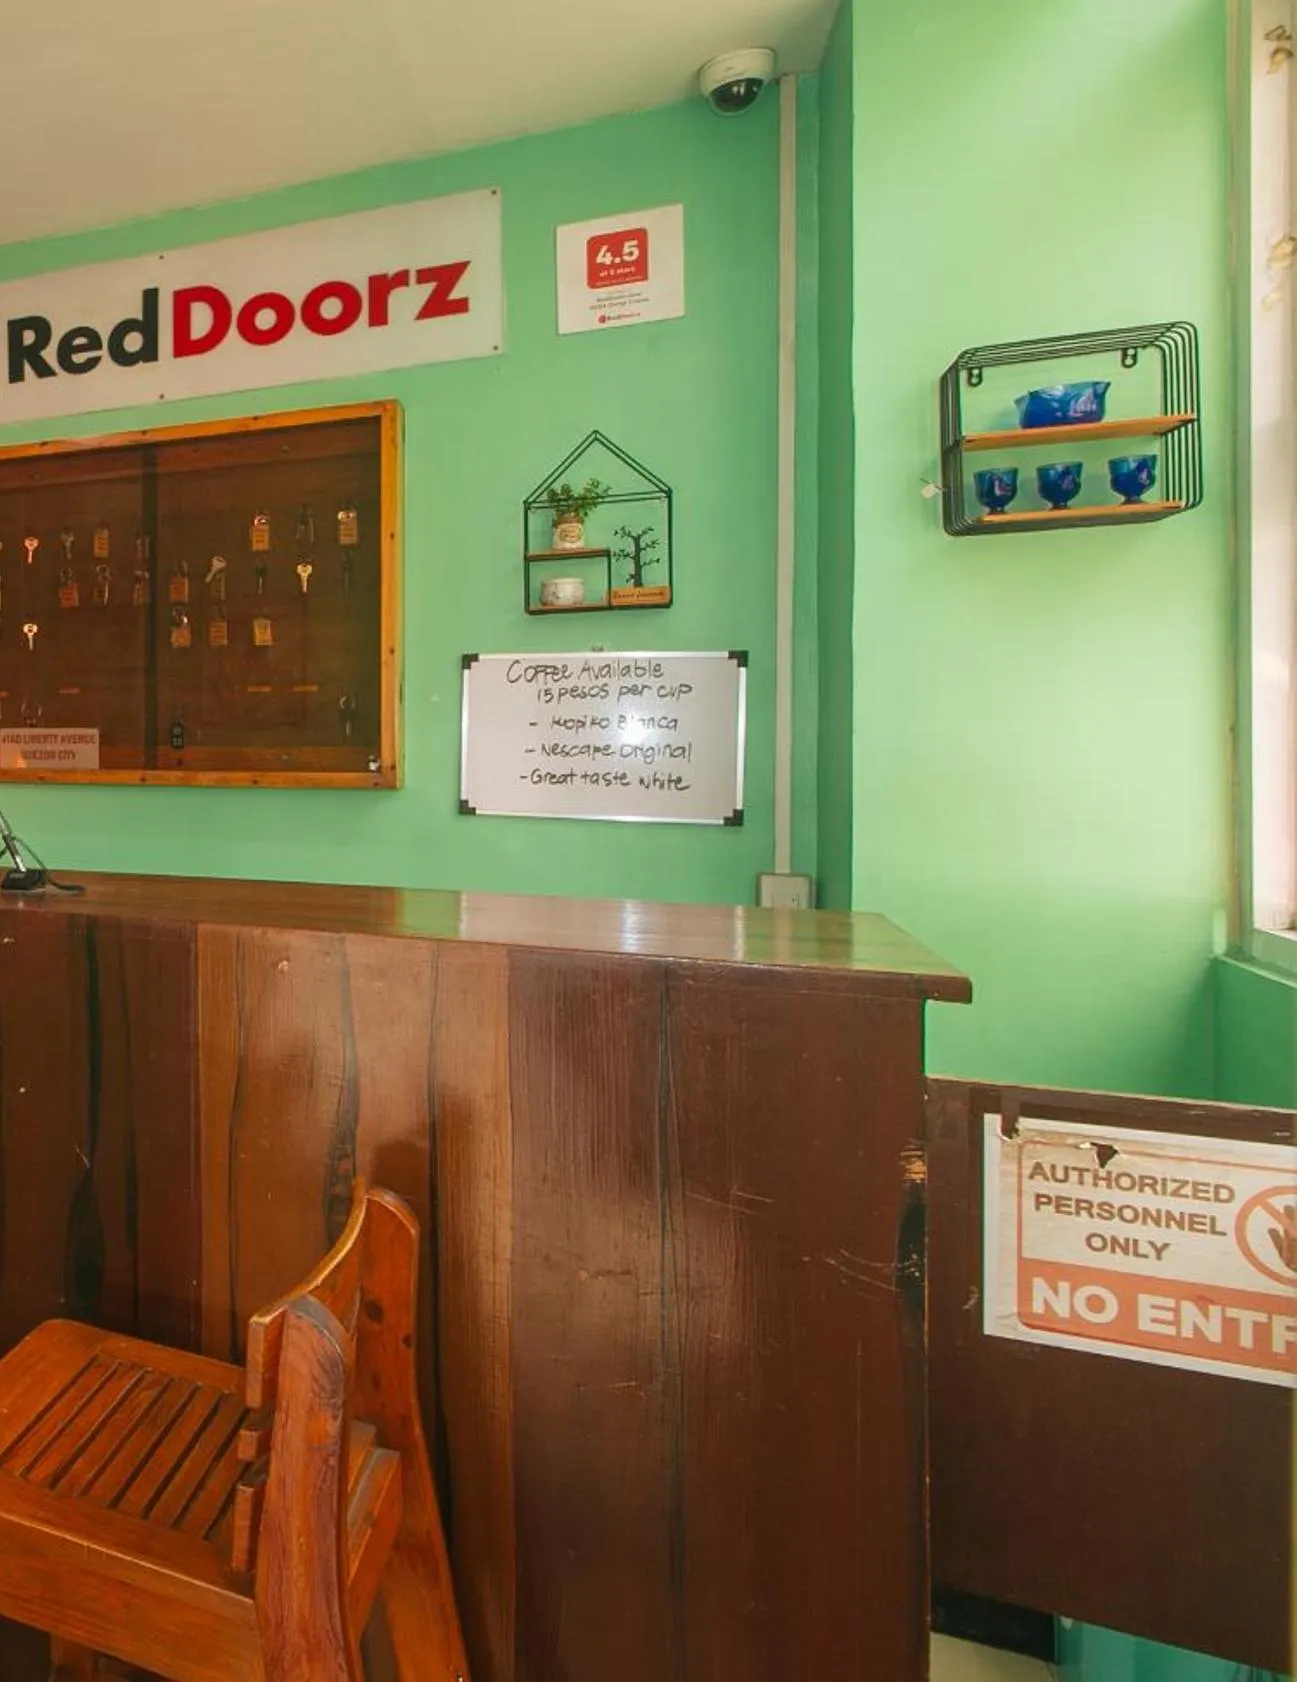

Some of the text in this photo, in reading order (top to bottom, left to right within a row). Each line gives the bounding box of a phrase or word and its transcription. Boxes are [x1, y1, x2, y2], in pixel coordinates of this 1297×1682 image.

[595, 240, 640, 266] 4.5
[7, 258, 472, 385] RedDoorz
[617, 684, 653, 703] per
[616, 715, 680, 732] Bnca
[1027, 1160, 1236, 1205] AUTHORIZED
[1033, 1193, 1228, 1238] PERSONNEL
[1085, 1231, 1172, 1262] ONLY
[1030, 1276, 1120, 1325] NO
